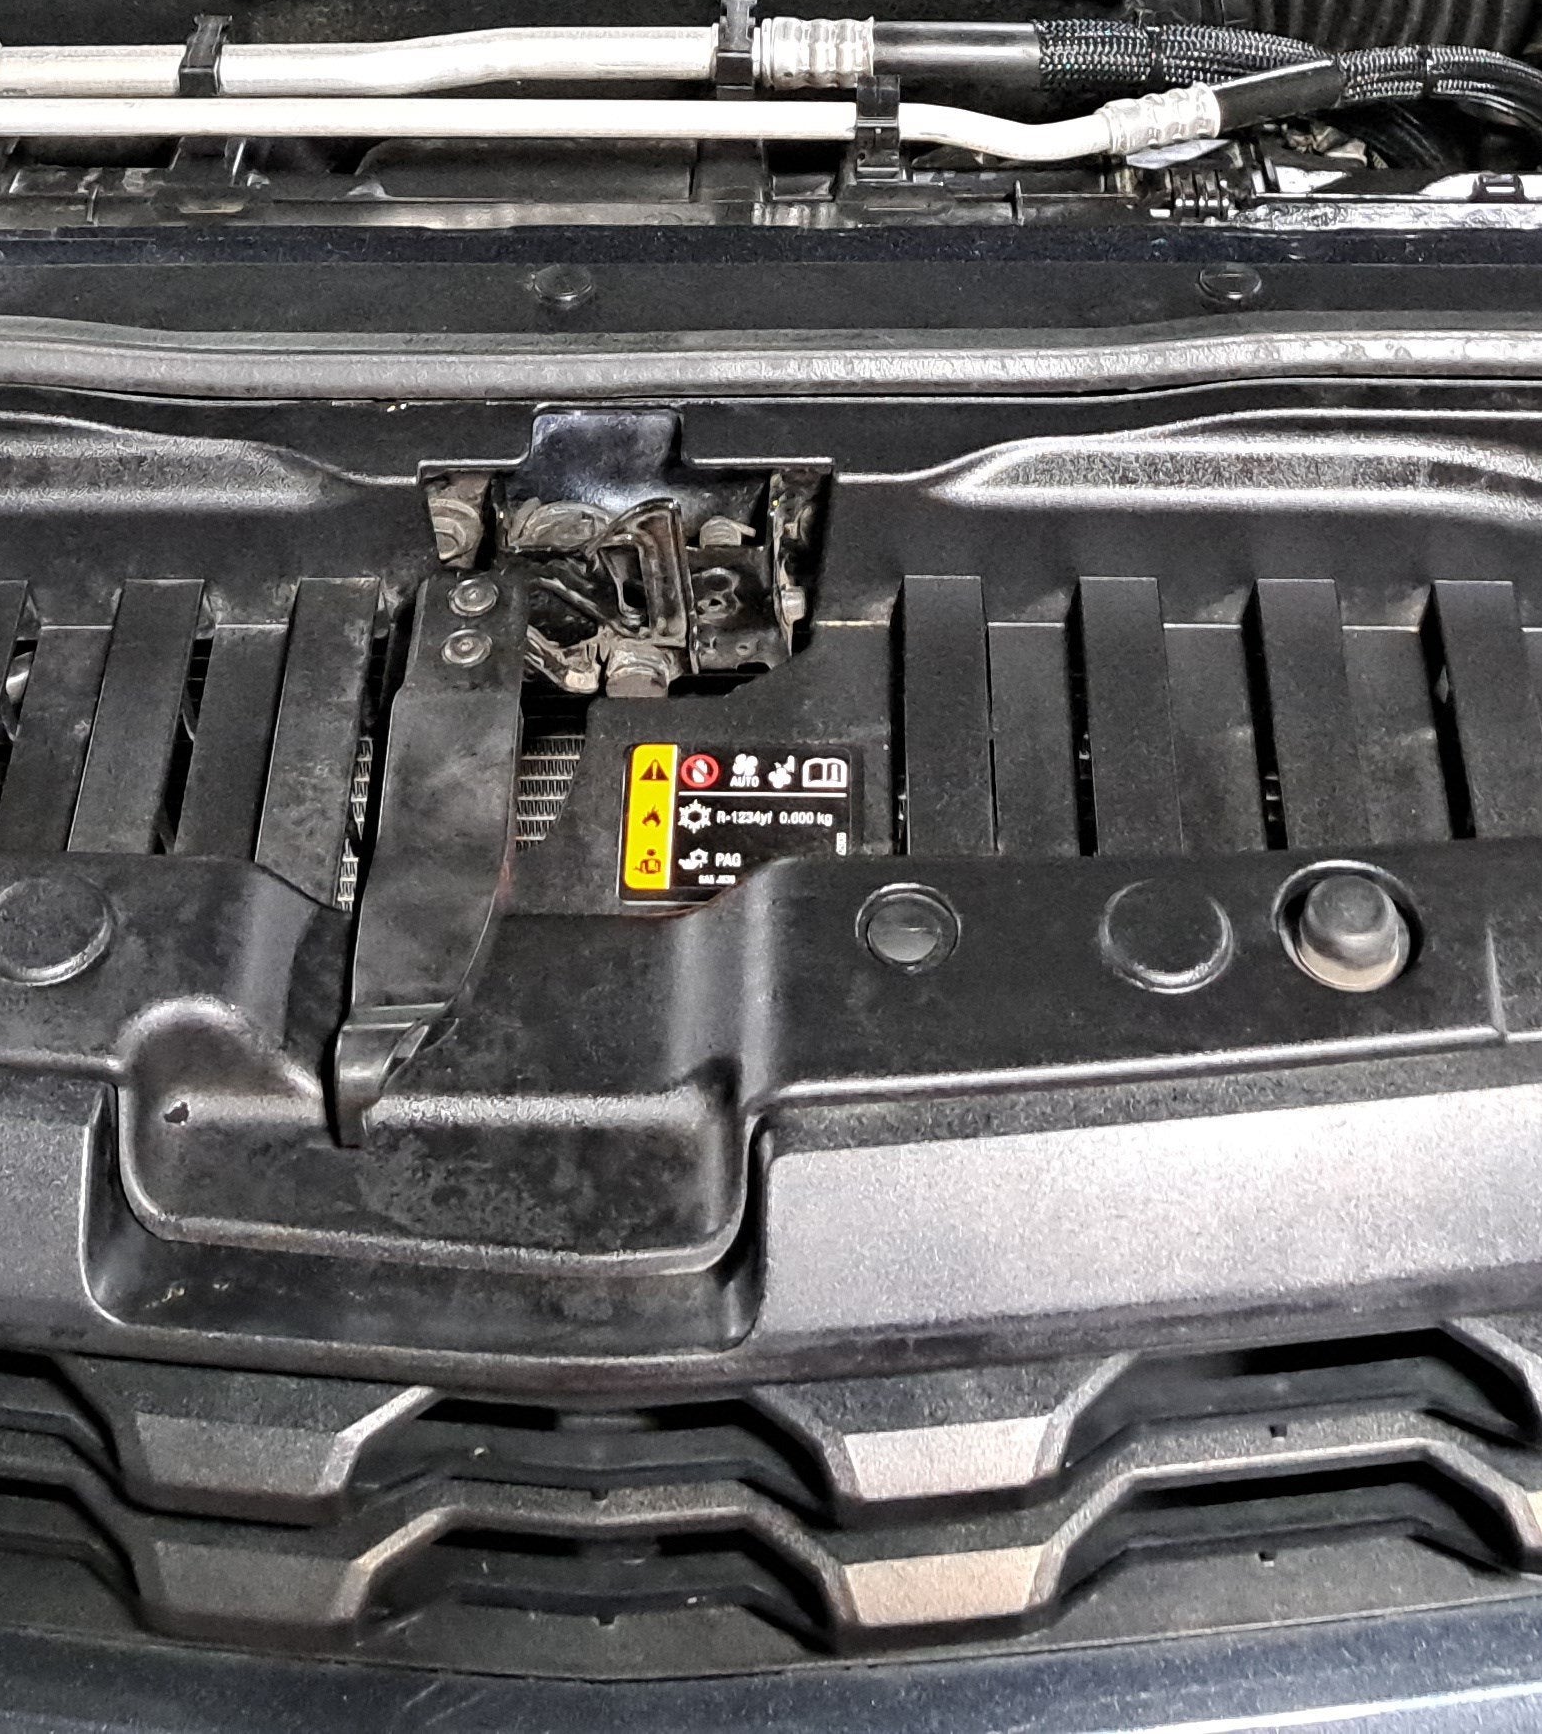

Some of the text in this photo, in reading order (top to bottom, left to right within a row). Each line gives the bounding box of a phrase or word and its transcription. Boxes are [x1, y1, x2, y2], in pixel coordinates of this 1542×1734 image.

[730, 775, 760, 788] AUTO
[716, 810, 773, 827] R-1234yf
[816, 811, 833, 828] kg
[715, 852, 742, 868] PAG
